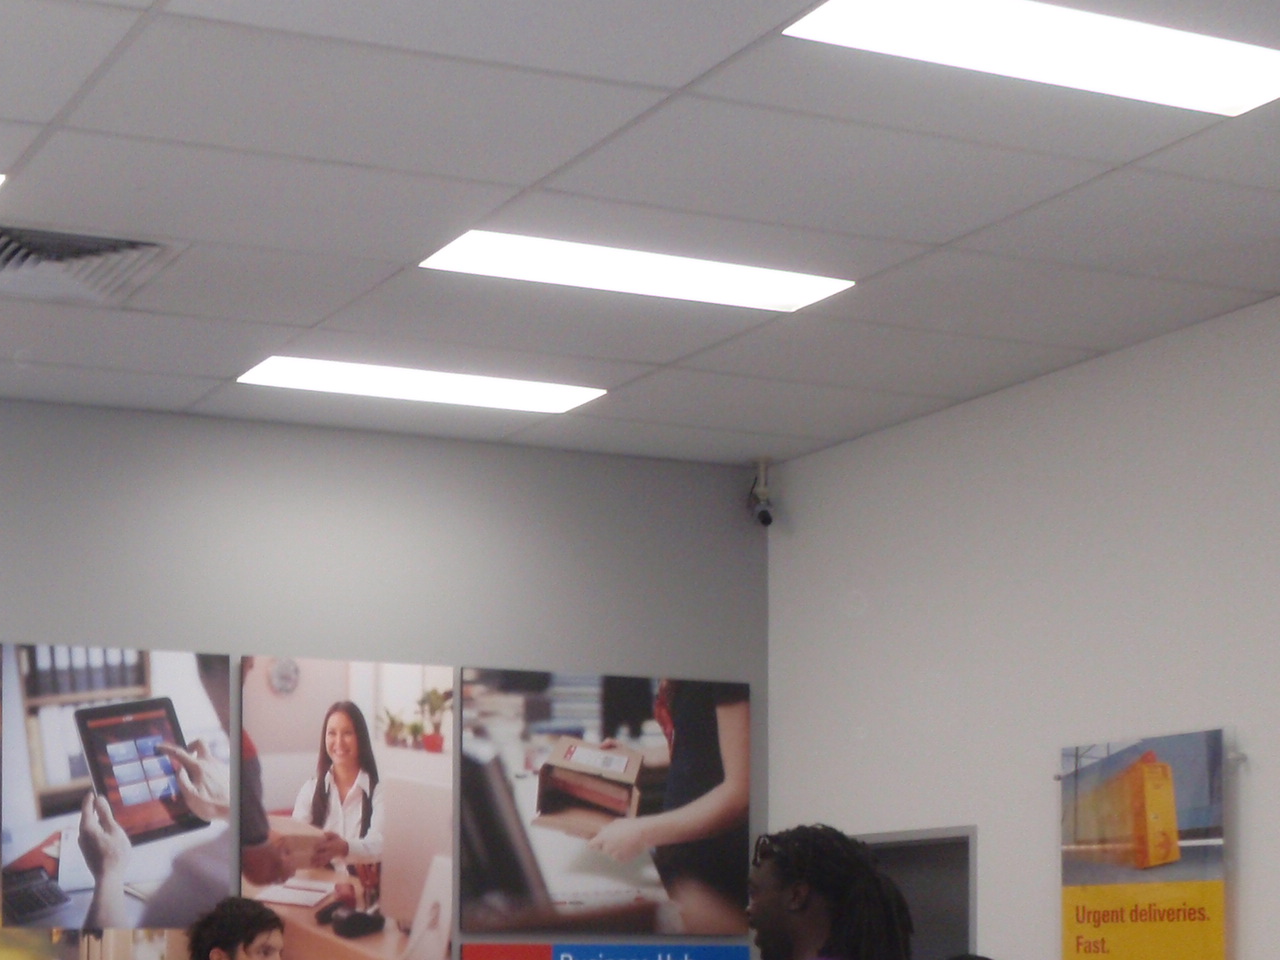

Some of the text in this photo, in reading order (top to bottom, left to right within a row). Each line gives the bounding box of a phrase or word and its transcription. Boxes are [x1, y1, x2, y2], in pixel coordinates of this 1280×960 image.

[1075, 902, 1210, 928] Urgent deliveries.
[1076, 935, 1110, 954] Fast.
